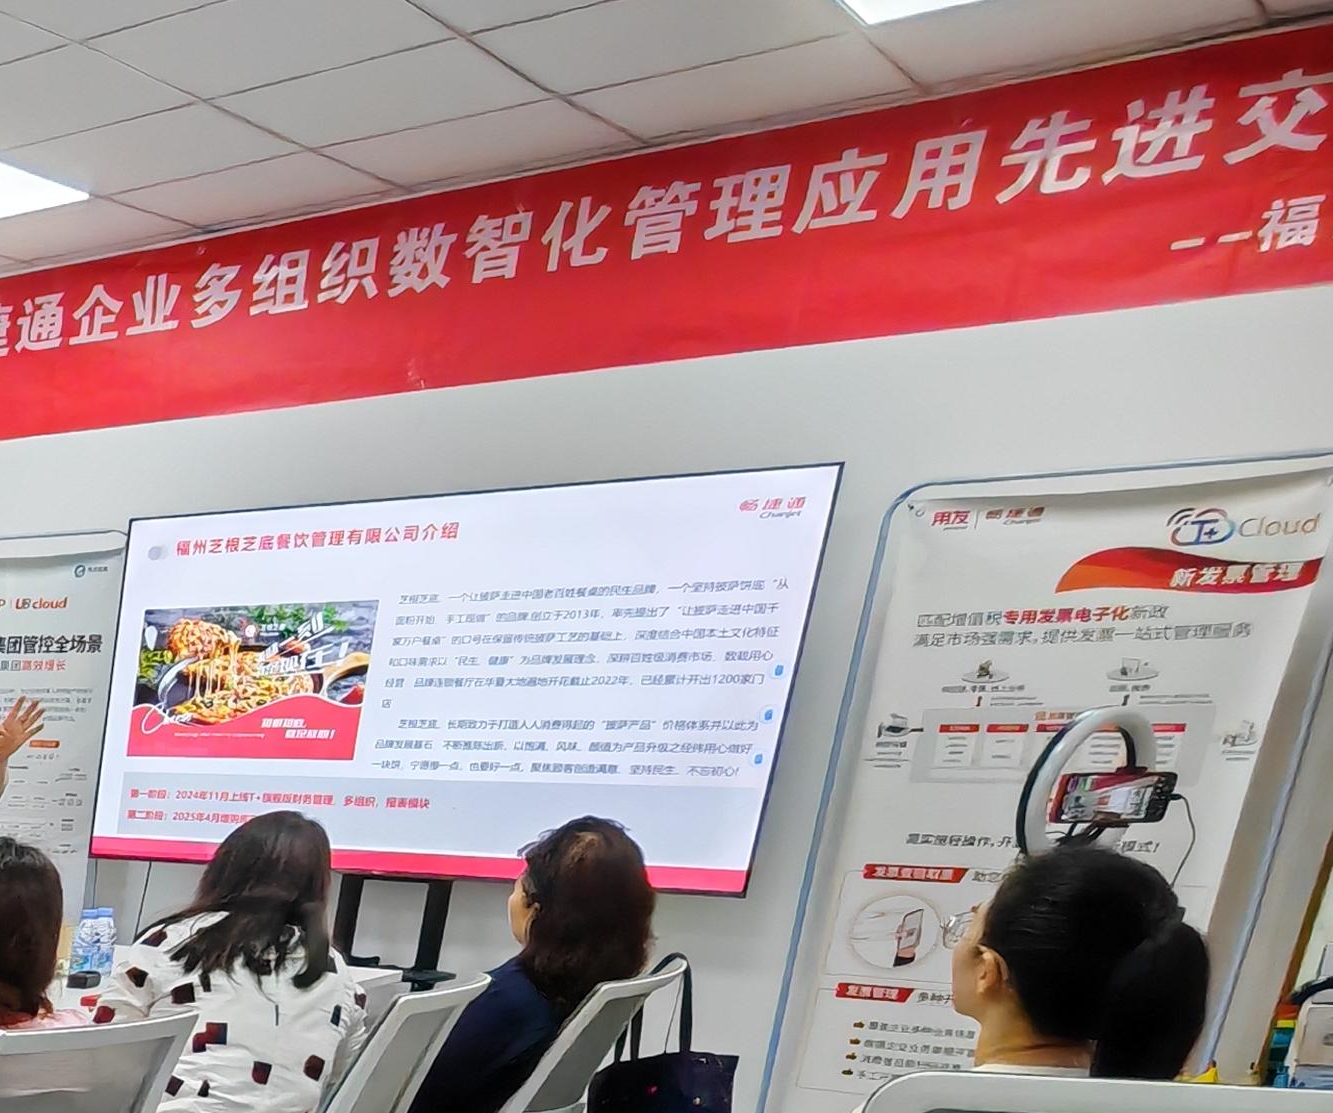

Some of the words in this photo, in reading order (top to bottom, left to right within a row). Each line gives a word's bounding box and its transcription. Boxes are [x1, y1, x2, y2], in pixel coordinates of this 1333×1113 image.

[932, 510, 970, 526] 用友
[1238, 512, 1321, 537] Cloud
[175, 522, 459, 557] 福州芝根芝底餐饮管理有限公司介绍
[1169, 562, 1305, 588] 新发票管理
